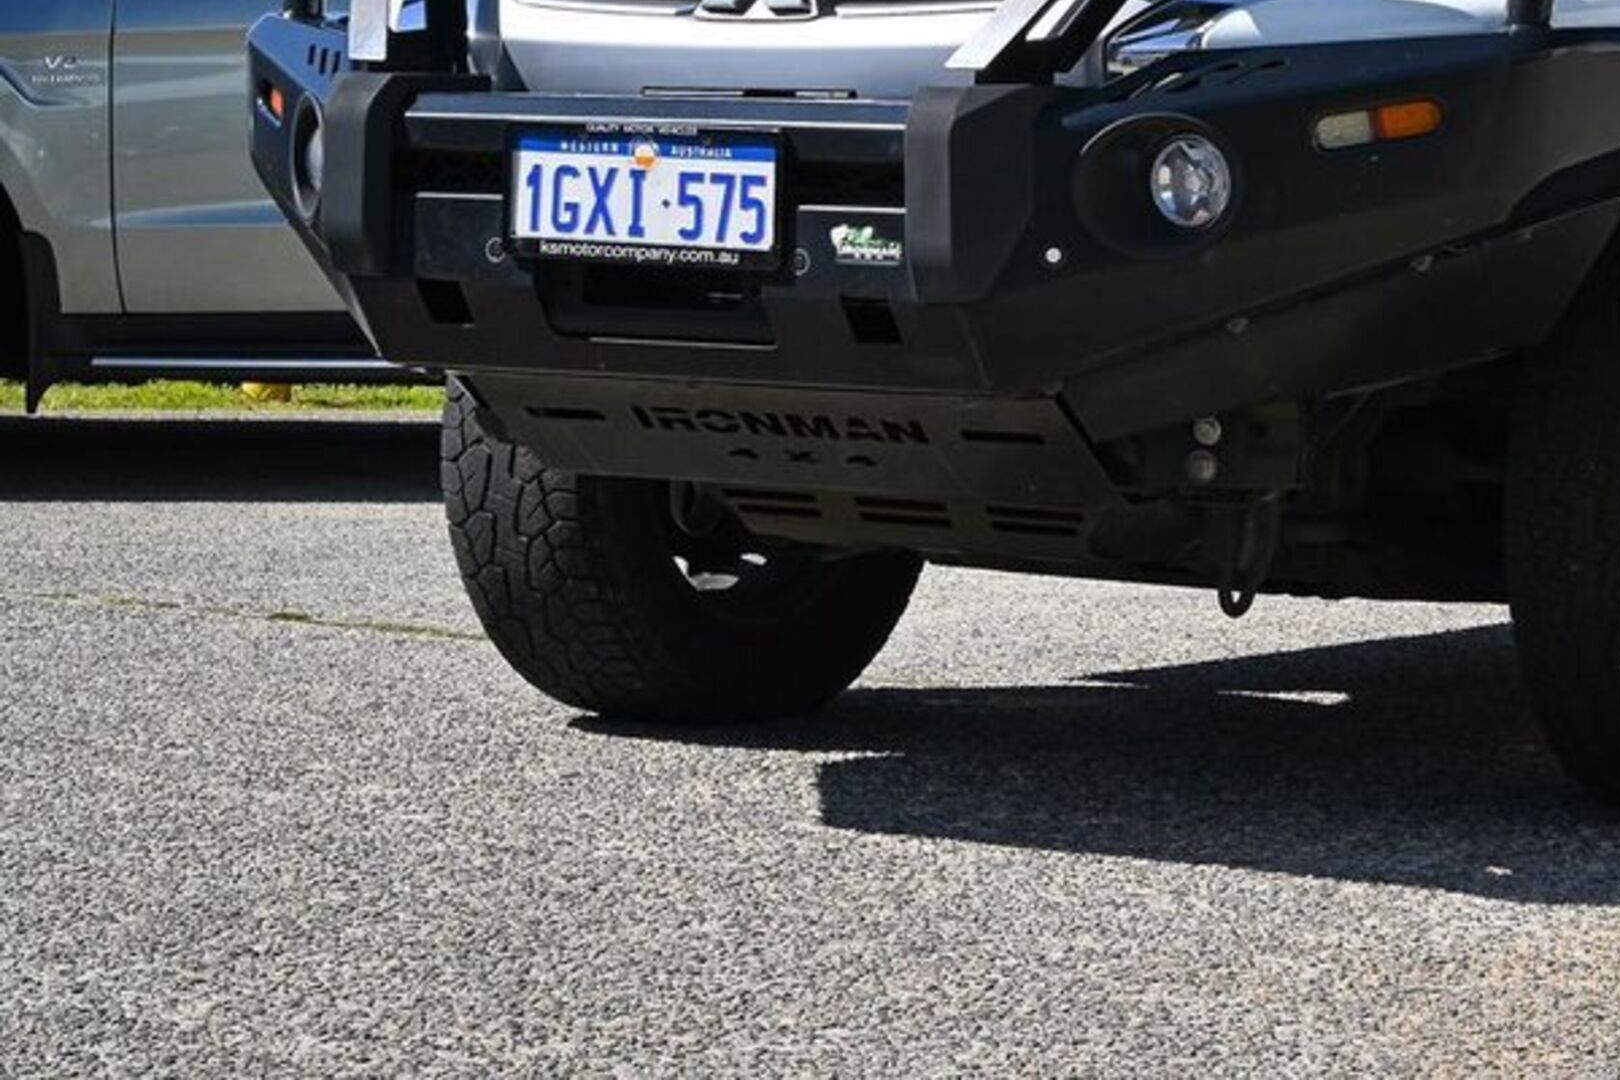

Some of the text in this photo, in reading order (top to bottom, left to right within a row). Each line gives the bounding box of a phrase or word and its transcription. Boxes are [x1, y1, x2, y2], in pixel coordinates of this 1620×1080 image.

[670, 145, 732, 158] AUSTRALIA
[539, 241, 740, 265] ksmotorcompany.com.au
[631, 405, 930, 444] IRONMAN
